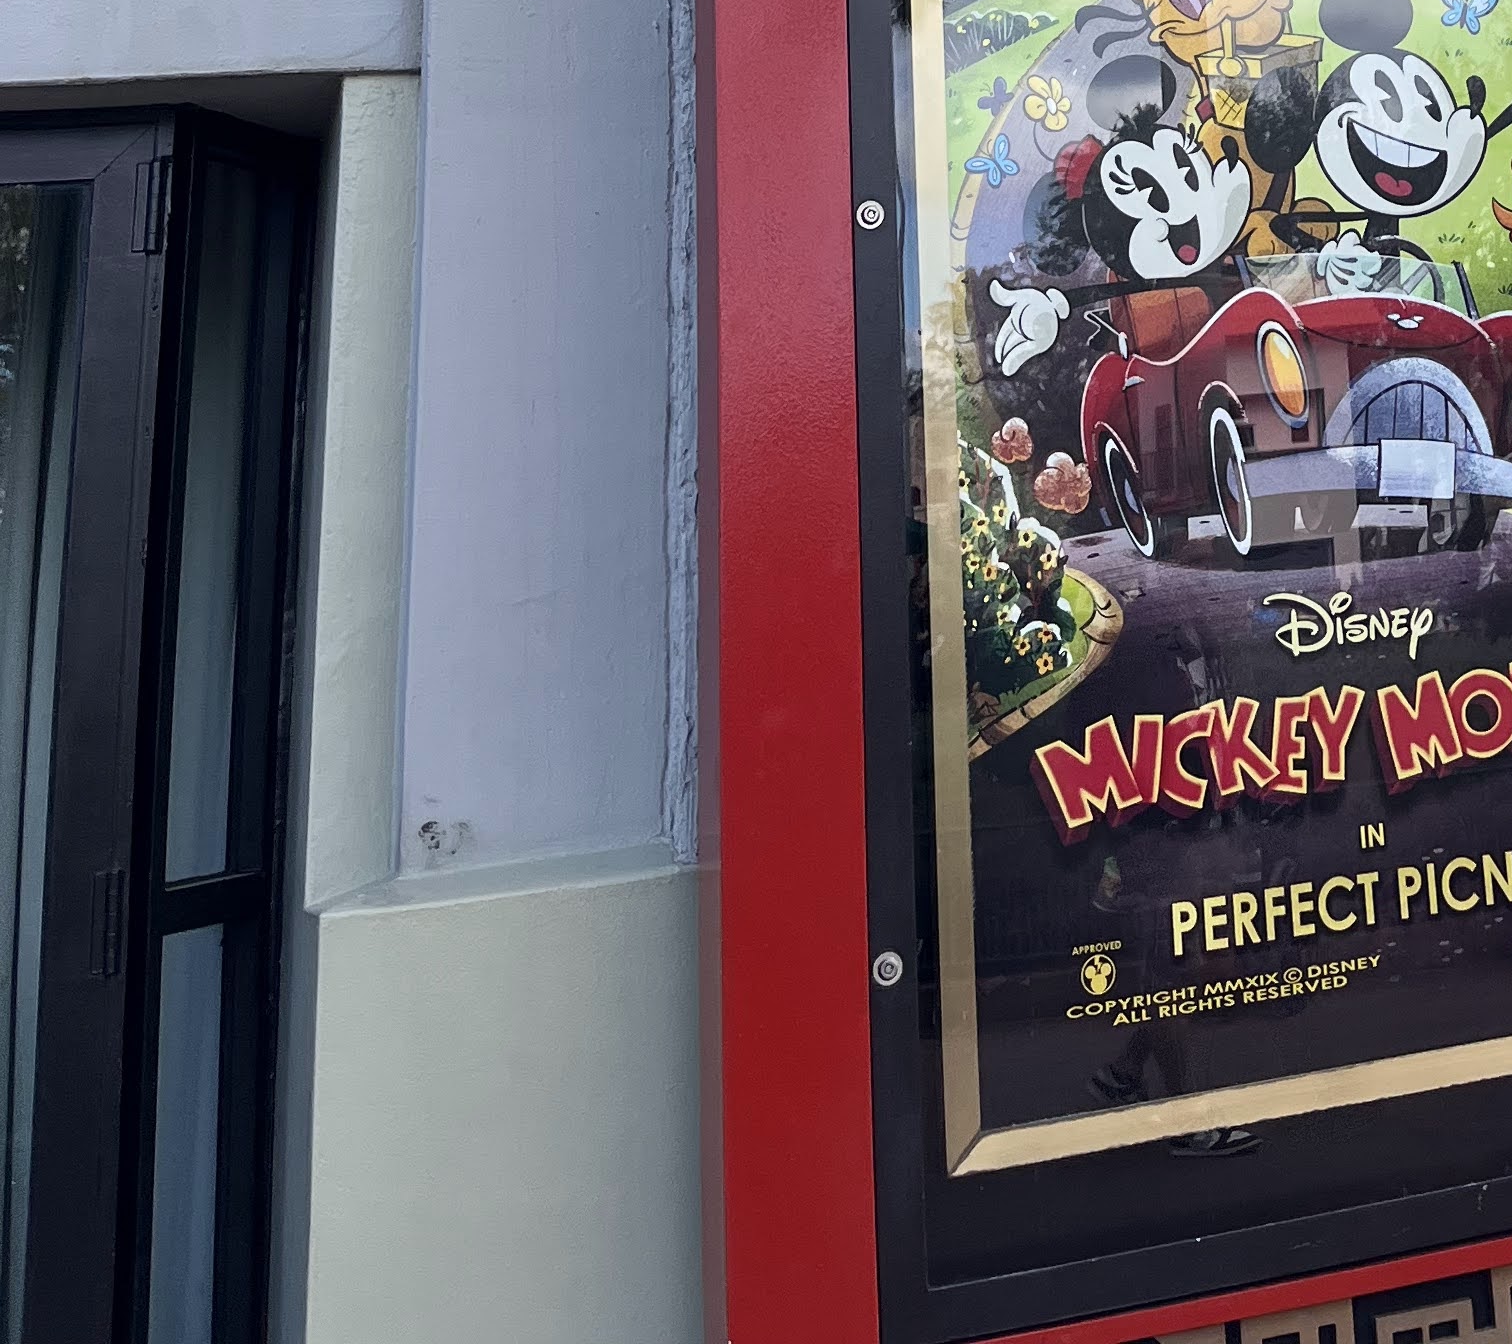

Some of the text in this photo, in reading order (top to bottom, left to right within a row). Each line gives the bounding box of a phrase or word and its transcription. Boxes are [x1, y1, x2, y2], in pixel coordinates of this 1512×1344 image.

[1033, 686, 1366, 830] MICKEY
[1359, 823, 1385, 849] IN
[1171, 872, 1380, 956] PERFECT
[1071, 940, 1122, 957] APPROVED
[1066, 985, 1198, 1020] COPYRIGHT
[1204, 971, 1280, 997] MMXIX
[1307, 954, 1382, 980] DISNEY
[1112, 974, 1349, 1027] ALL RIGHTS RESERVED
